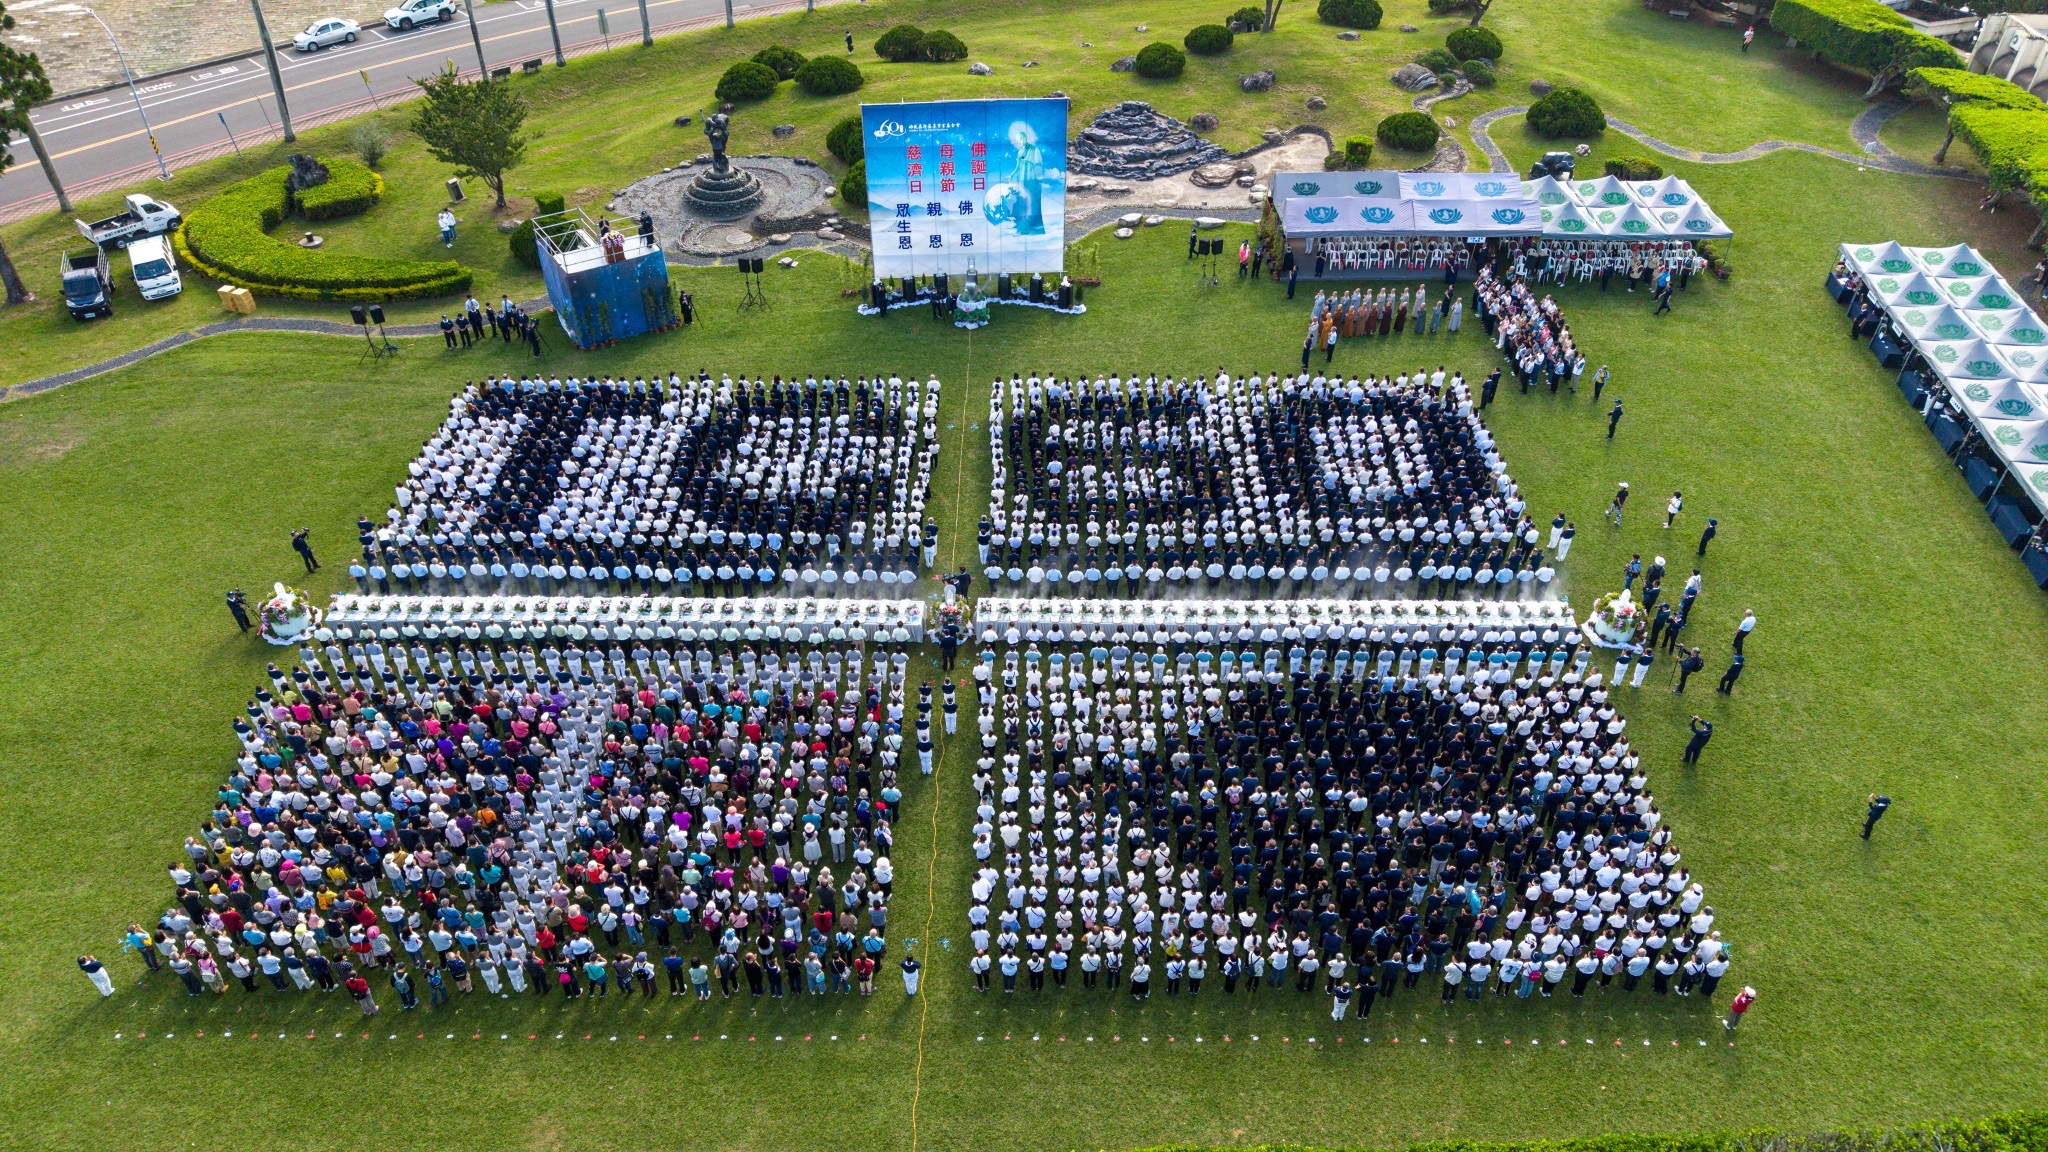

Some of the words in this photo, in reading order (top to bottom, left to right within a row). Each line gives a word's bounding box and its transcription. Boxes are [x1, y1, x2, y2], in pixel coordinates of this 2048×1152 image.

[907, 144, 922, 193] 慈濟日
[940, 143, 955, 192] 母親節
[971, 141, 987, 191] 佛誕日
[896, 203, 912, 249] 眾生恩
[926, 201, 943, 249] 親恩
[958, 199, 974, 247] 佛恩
